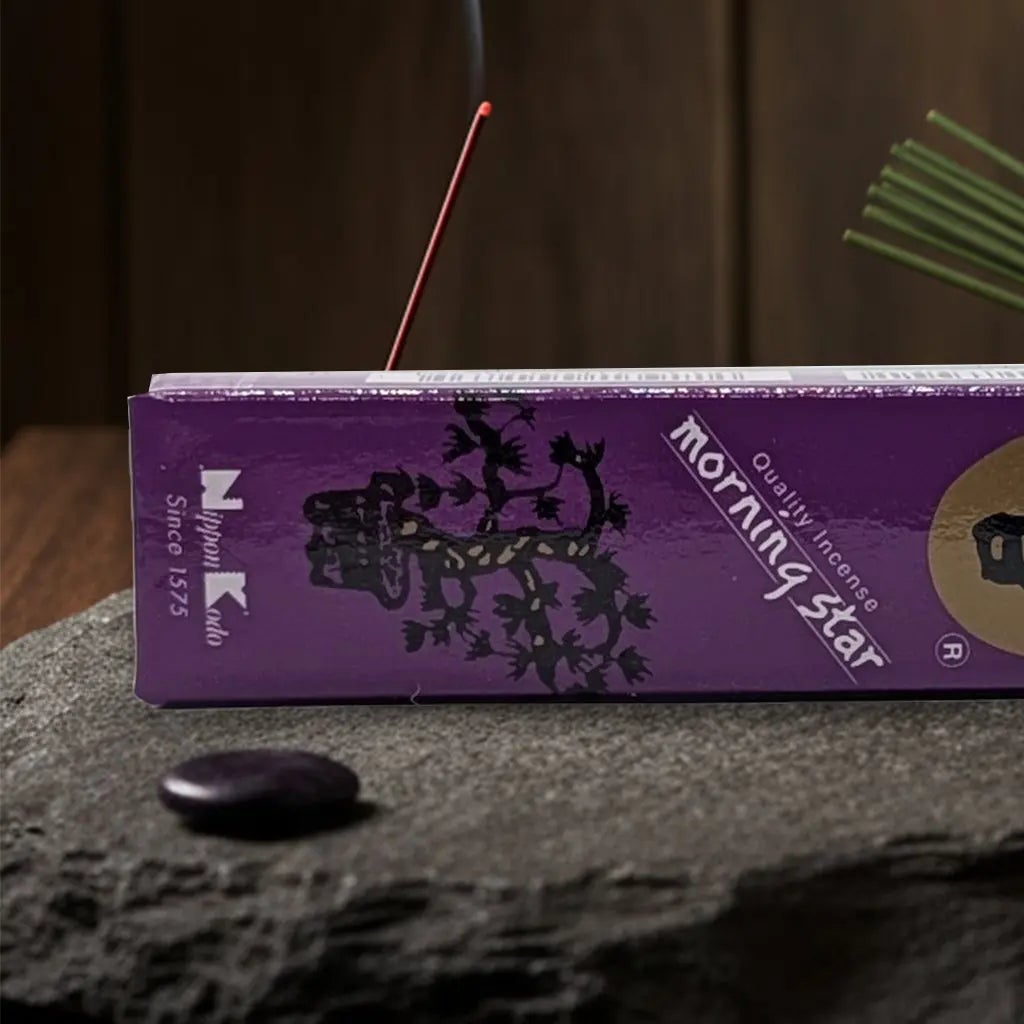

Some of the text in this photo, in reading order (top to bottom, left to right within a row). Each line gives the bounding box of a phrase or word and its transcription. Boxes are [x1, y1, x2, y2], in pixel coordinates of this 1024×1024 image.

[166, 493, 189, 618] Since 1575
[194, 469, 247, 647] Nippon Kodo
[751, 451, 879, 613] Quality Incense
